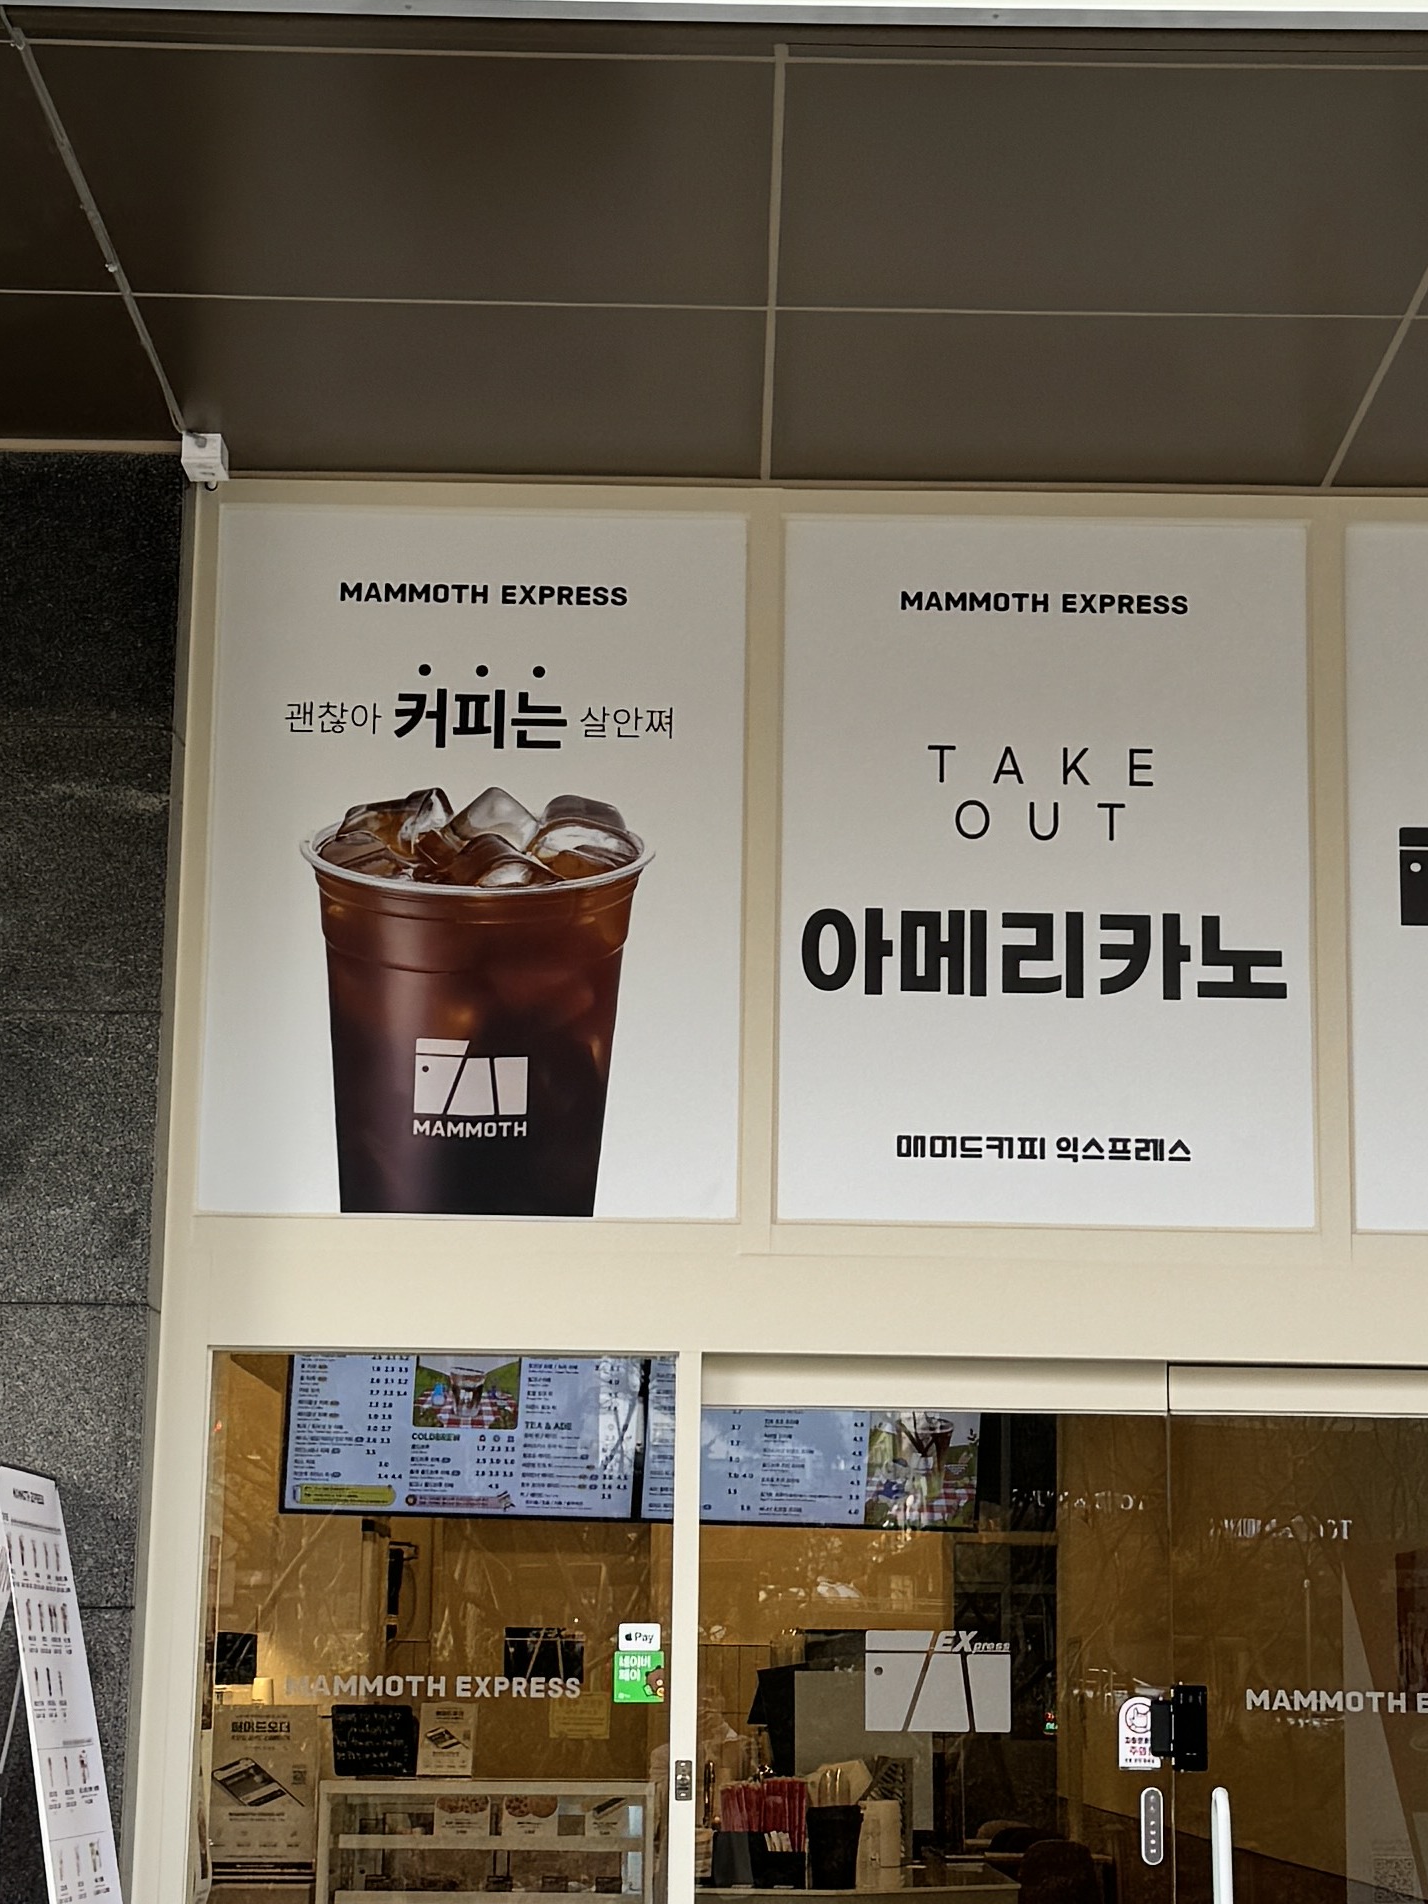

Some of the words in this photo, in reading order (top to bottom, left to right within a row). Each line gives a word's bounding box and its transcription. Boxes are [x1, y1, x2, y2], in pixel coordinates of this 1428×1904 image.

[339, 582, 489, 604] MAMMOTH
[501, 585, 628, 607] EXPRESS
[900, 591, 1049, 613] MAMMOTH
[1062, 593, 1188, 615] EXPRESS
[284, 700, 382, 735] 괜찮아
[394, 687, 567, 750] 커피는
[579, 706, 674, 740] 살안쪄
[928, 745, 1154, 787] TAKE
[954, 799, 1125, 841] OUT
[801, 907, 1287, 1000] 아메리카노
[413, 1120, 527, 1138] MAMMOTH
[896, 1135, 1045, 1159] 매머드커피
[1056, 1137, 1191, 1163] 익스프레스
[634, 1633, 654, 1644] Pay
[285, 1675, 445, 1698] MAMMOTH
[456, 1676, 581, 1699] EXPRESS
[1246, 1689, 1407, 1714] MAMMOTH
